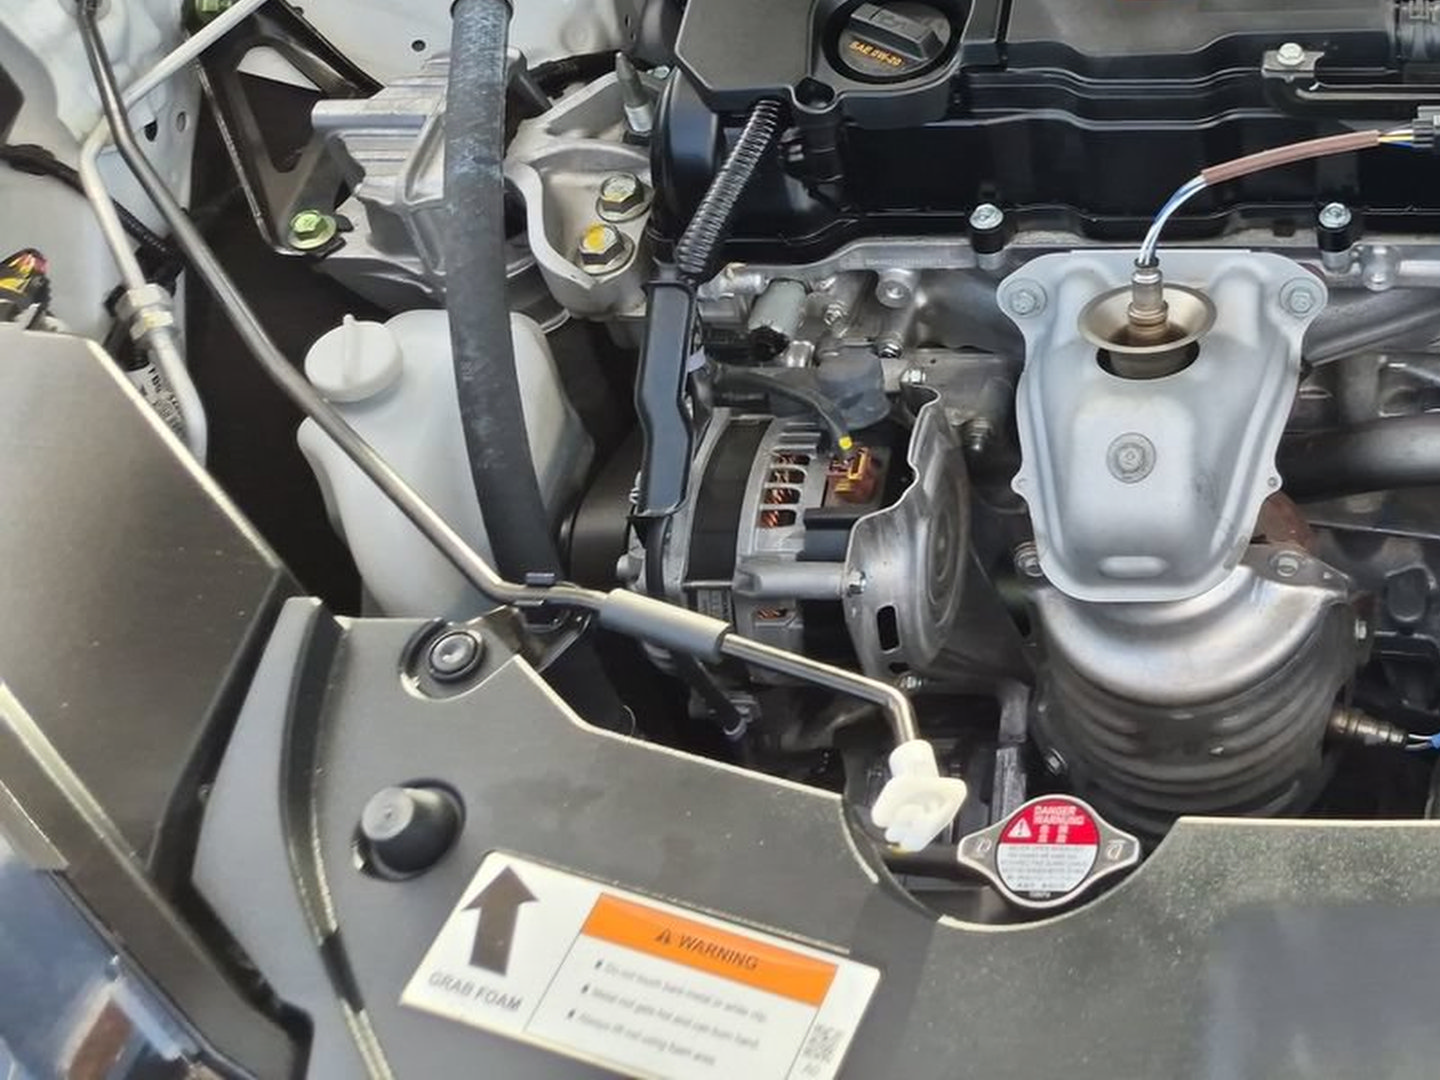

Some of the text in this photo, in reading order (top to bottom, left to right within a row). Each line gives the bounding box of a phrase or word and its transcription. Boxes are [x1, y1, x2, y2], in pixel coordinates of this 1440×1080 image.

[849, 41, 873, 55] SAE
[1034, 805, 1076, 816] DANGER
[679, 934, 758, 970] WARNING
[430, 973, 523, 1010] GRAB FOAM
